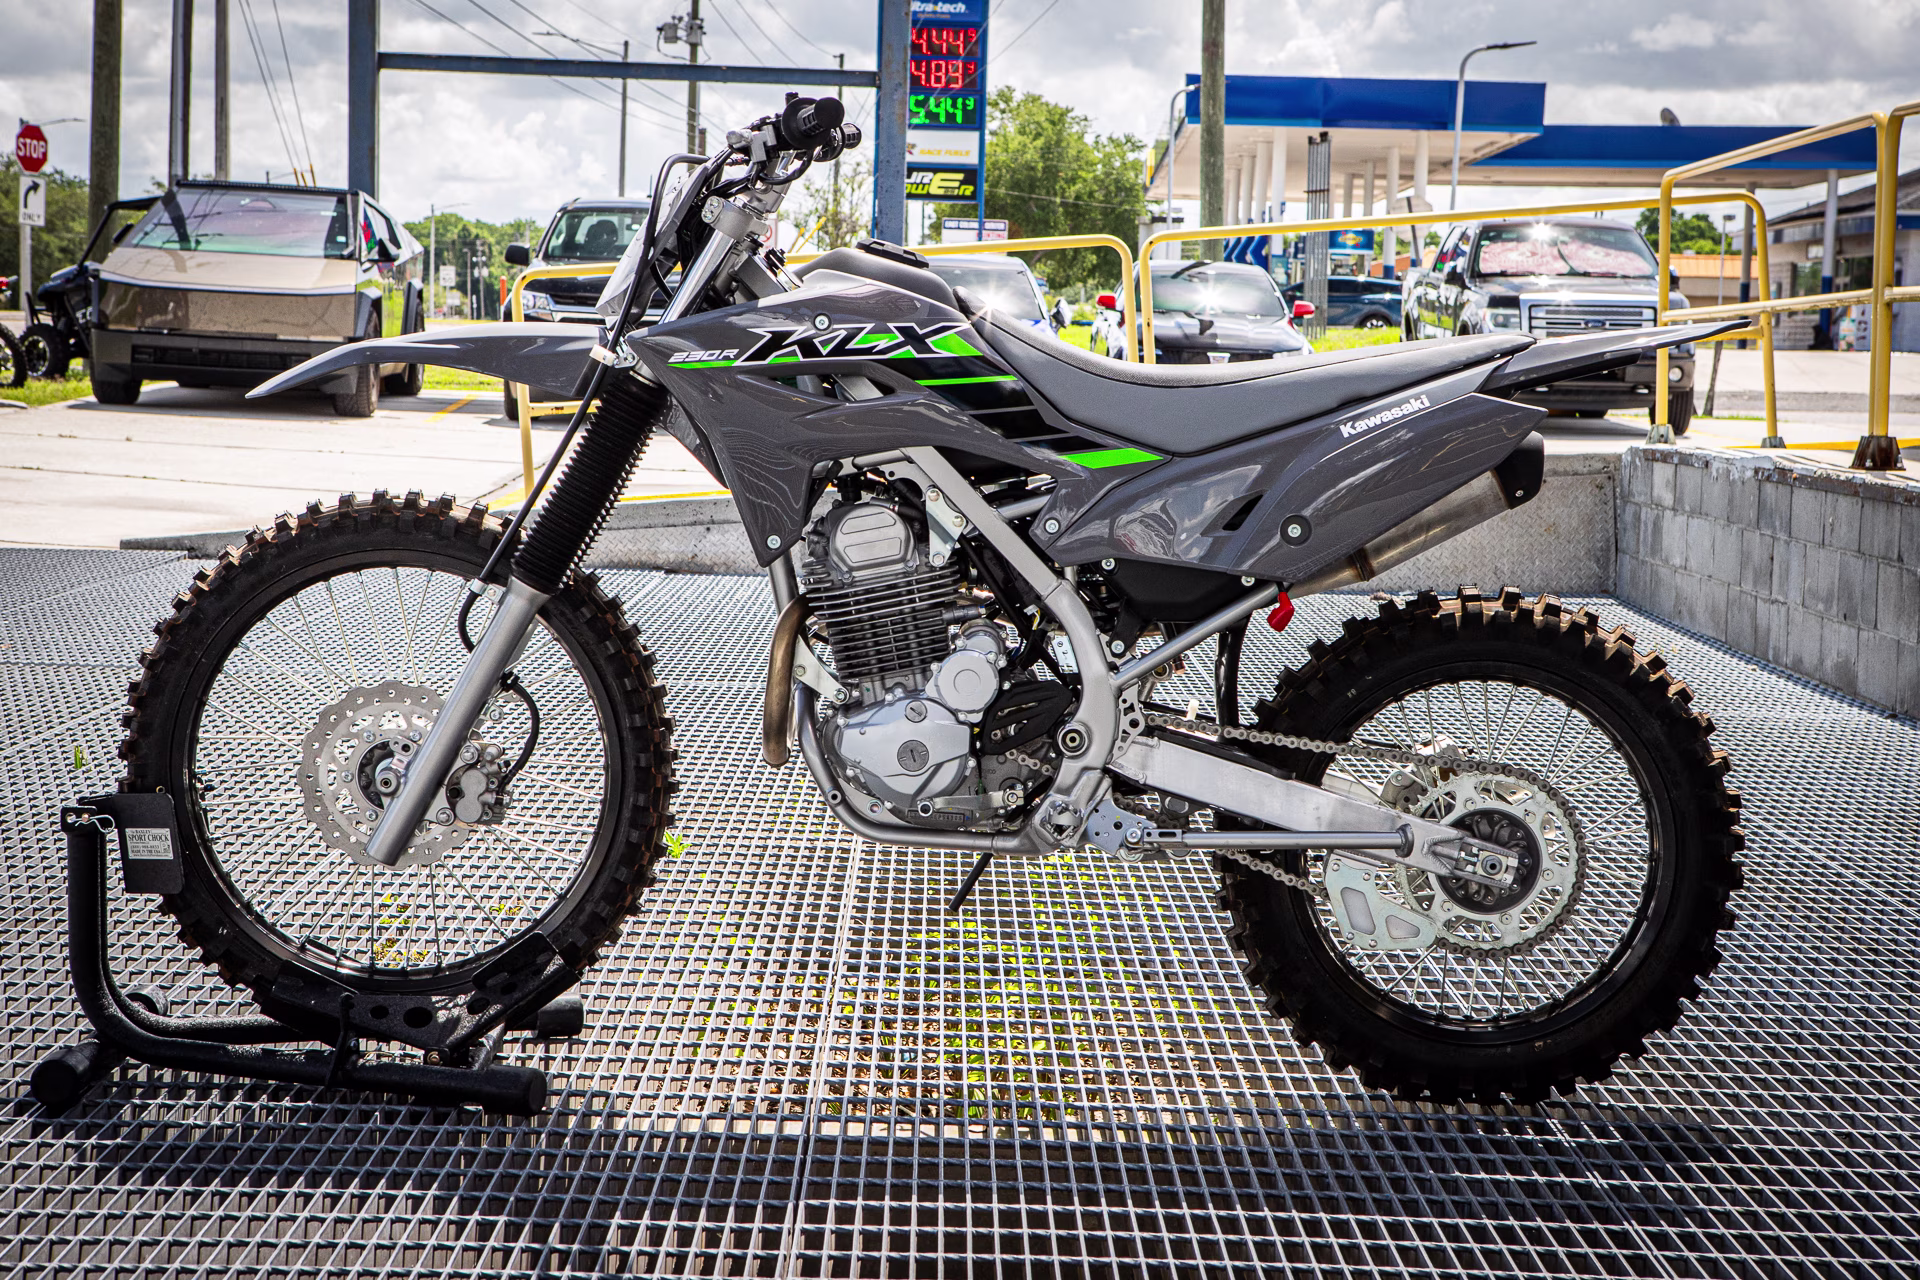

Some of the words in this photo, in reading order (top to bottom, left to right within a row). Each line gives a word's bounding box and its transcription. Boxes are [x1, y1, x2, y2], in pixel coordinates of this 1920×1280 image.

[17, 137, 46, 159] STOP
[732, 322, 971, 367] KLX
[667, 349, 740, 363] 230R
[1339, 394, 1431, 438] Kawasaki
[147, 834, 169, 842] CHOCK
